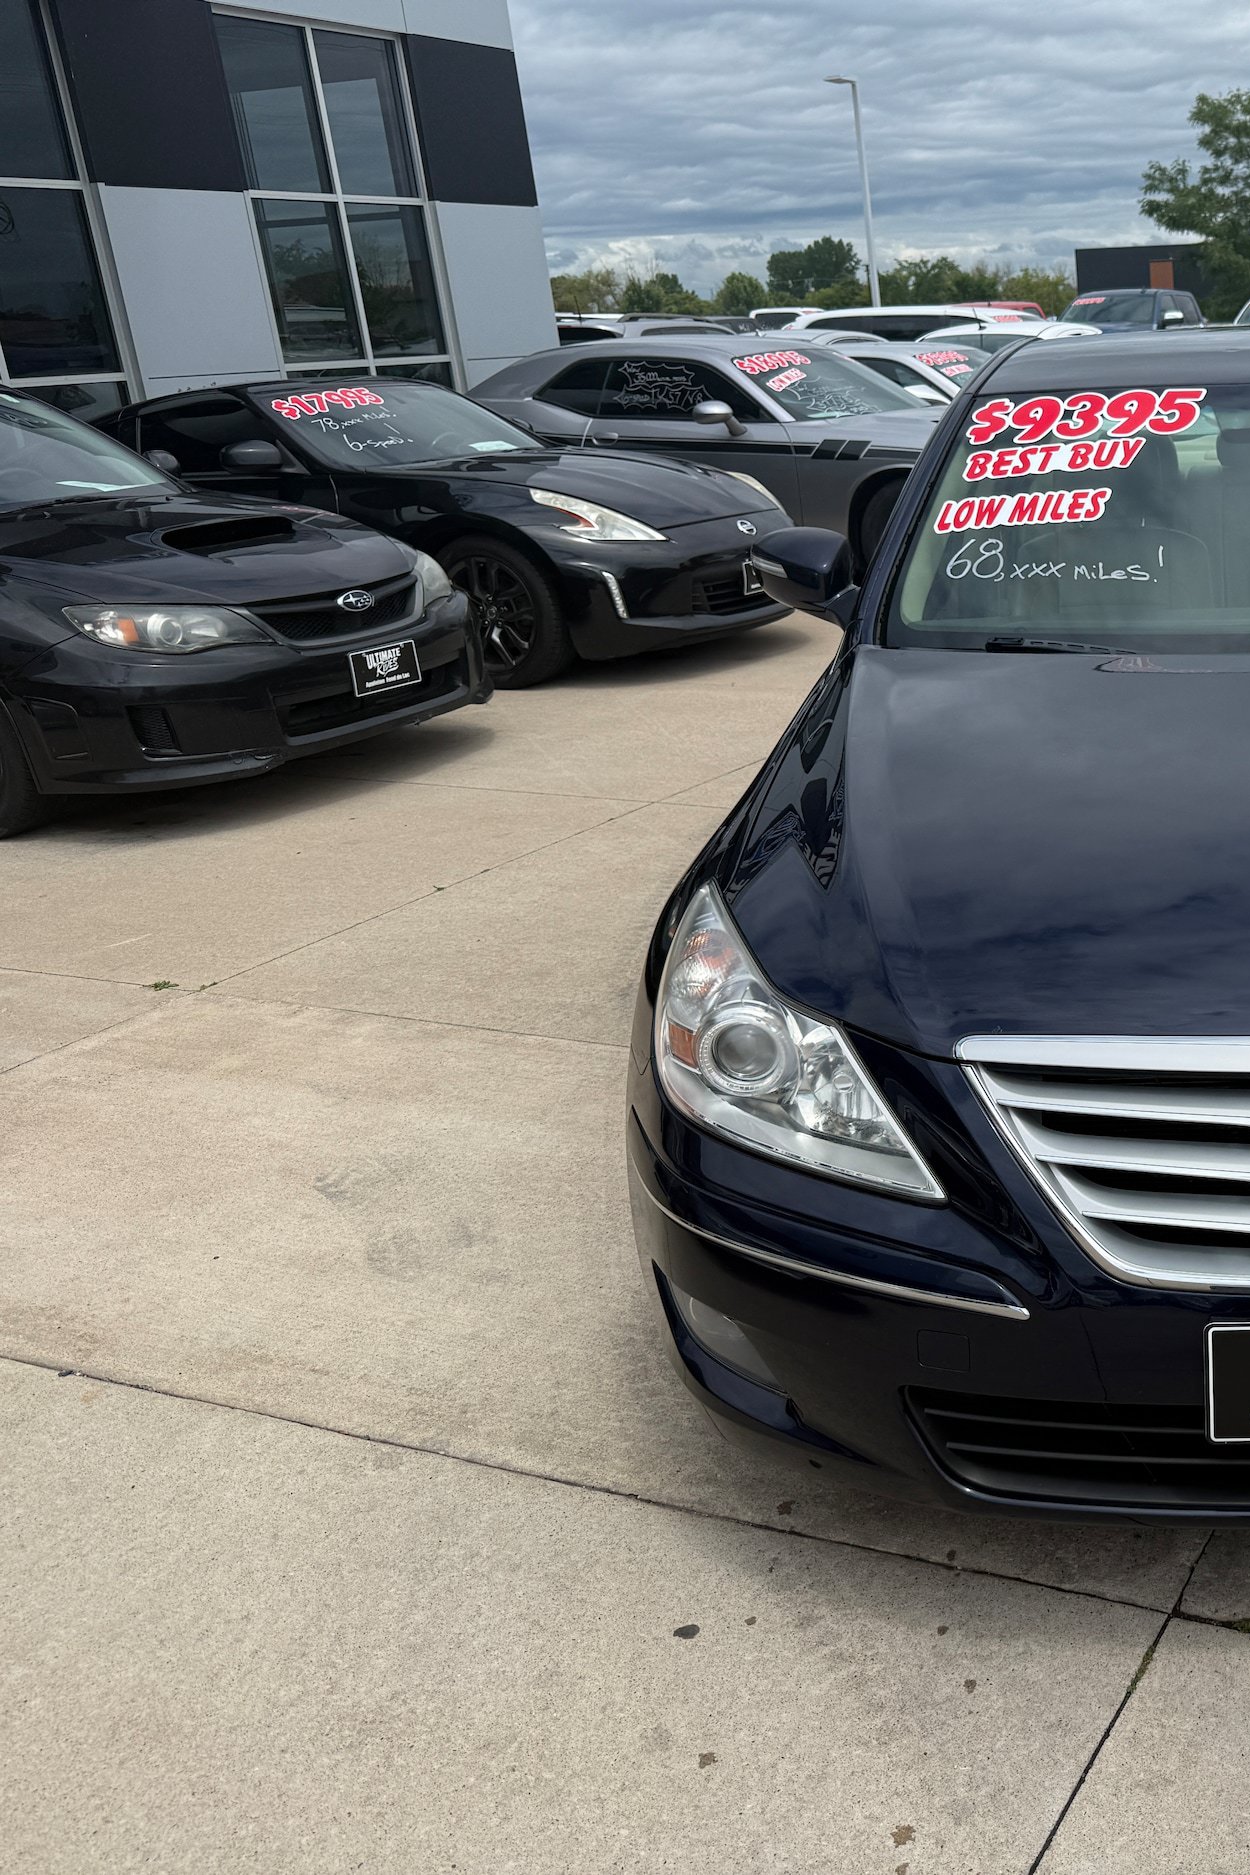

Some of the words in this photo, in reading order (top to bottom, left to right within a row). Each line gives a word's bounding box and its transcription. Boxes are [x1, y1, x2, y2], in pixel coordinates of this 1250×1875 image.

[272, 387, 384, 420] $17995
[966, 388, 1207, 444] $9395
[965, 445, 1062, 481] BEST
[1066, 439, 1145, 470] BUY
[936, 498, 1007, 533] LOW
[1007, 490, 1108, 524] MILES
[365, 647, 401, 669] ULTIMATE
